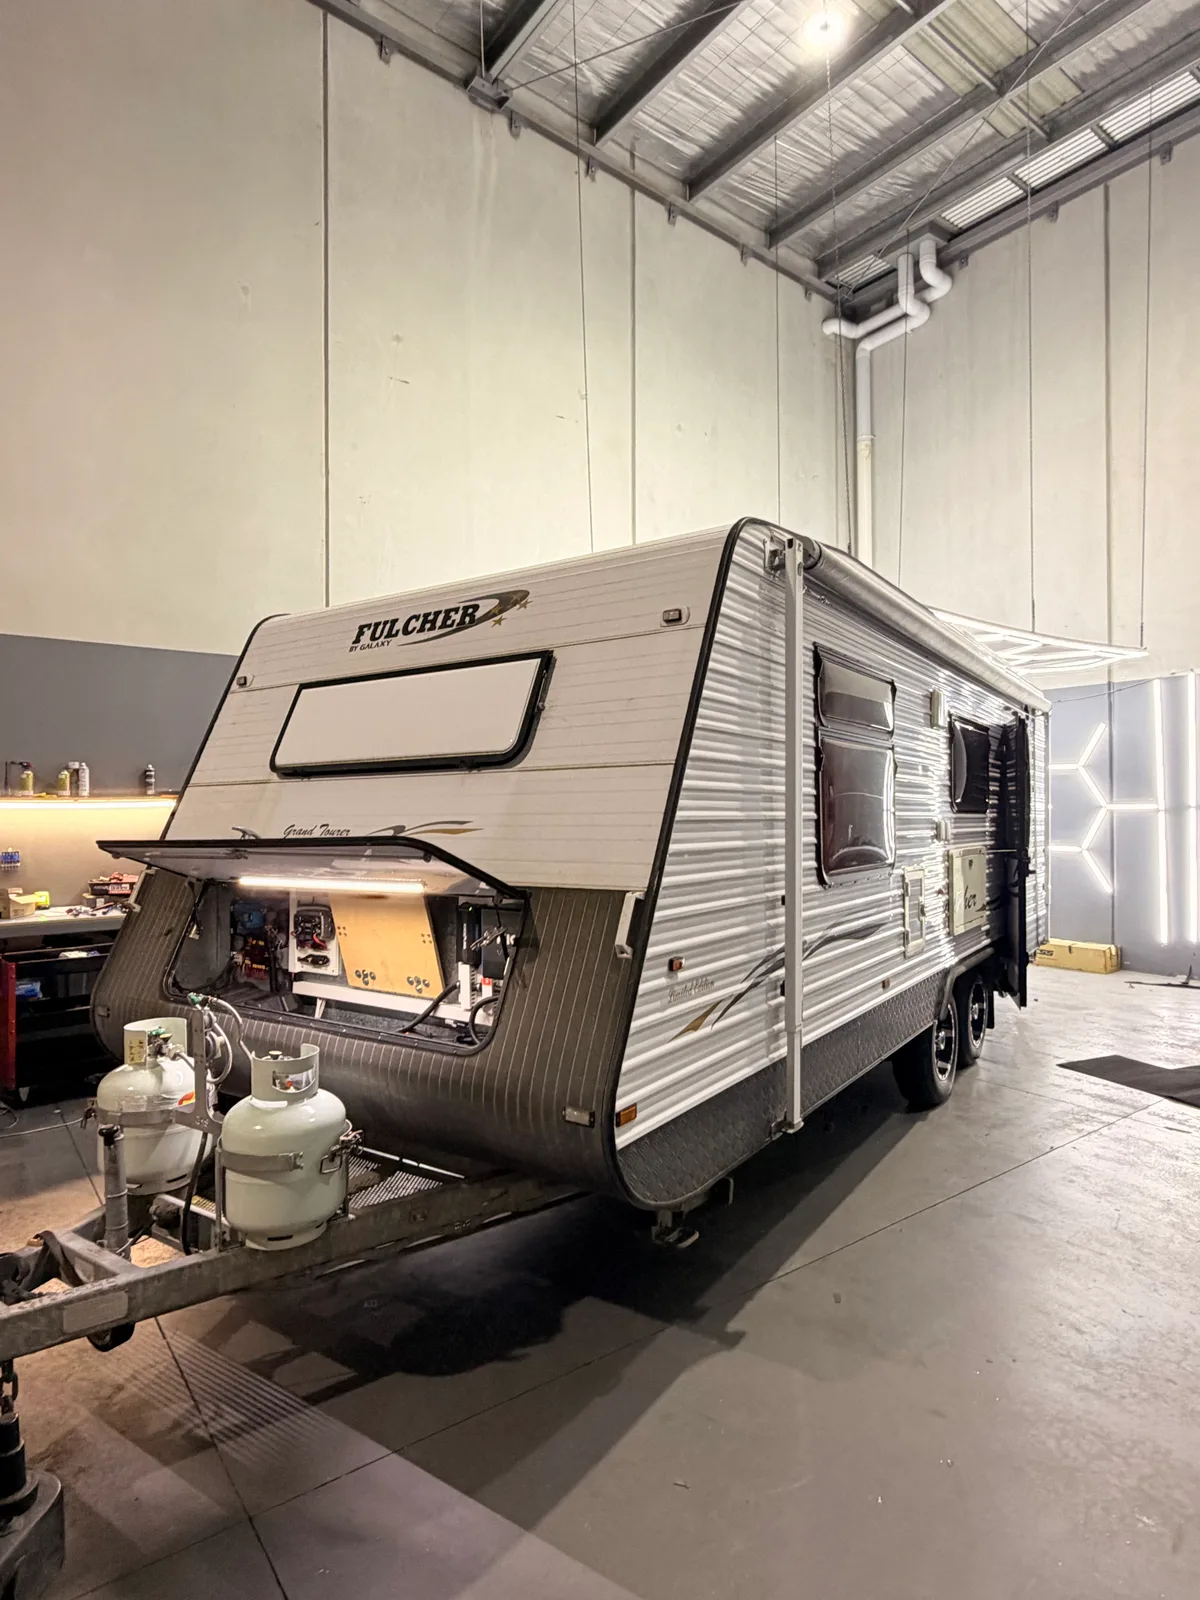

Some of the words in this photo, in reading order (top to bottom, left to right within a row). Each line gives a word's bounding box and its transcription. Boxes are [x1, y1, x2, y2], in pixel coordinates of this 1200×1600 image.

[351, 603, 480, 645] FULCHER
[349, 644, 359, 653] BY
[360, 639, 392, 652] GALAXY
[283, 824, 317, 839] Grand
[319, 823, 351, 837] Tourer
